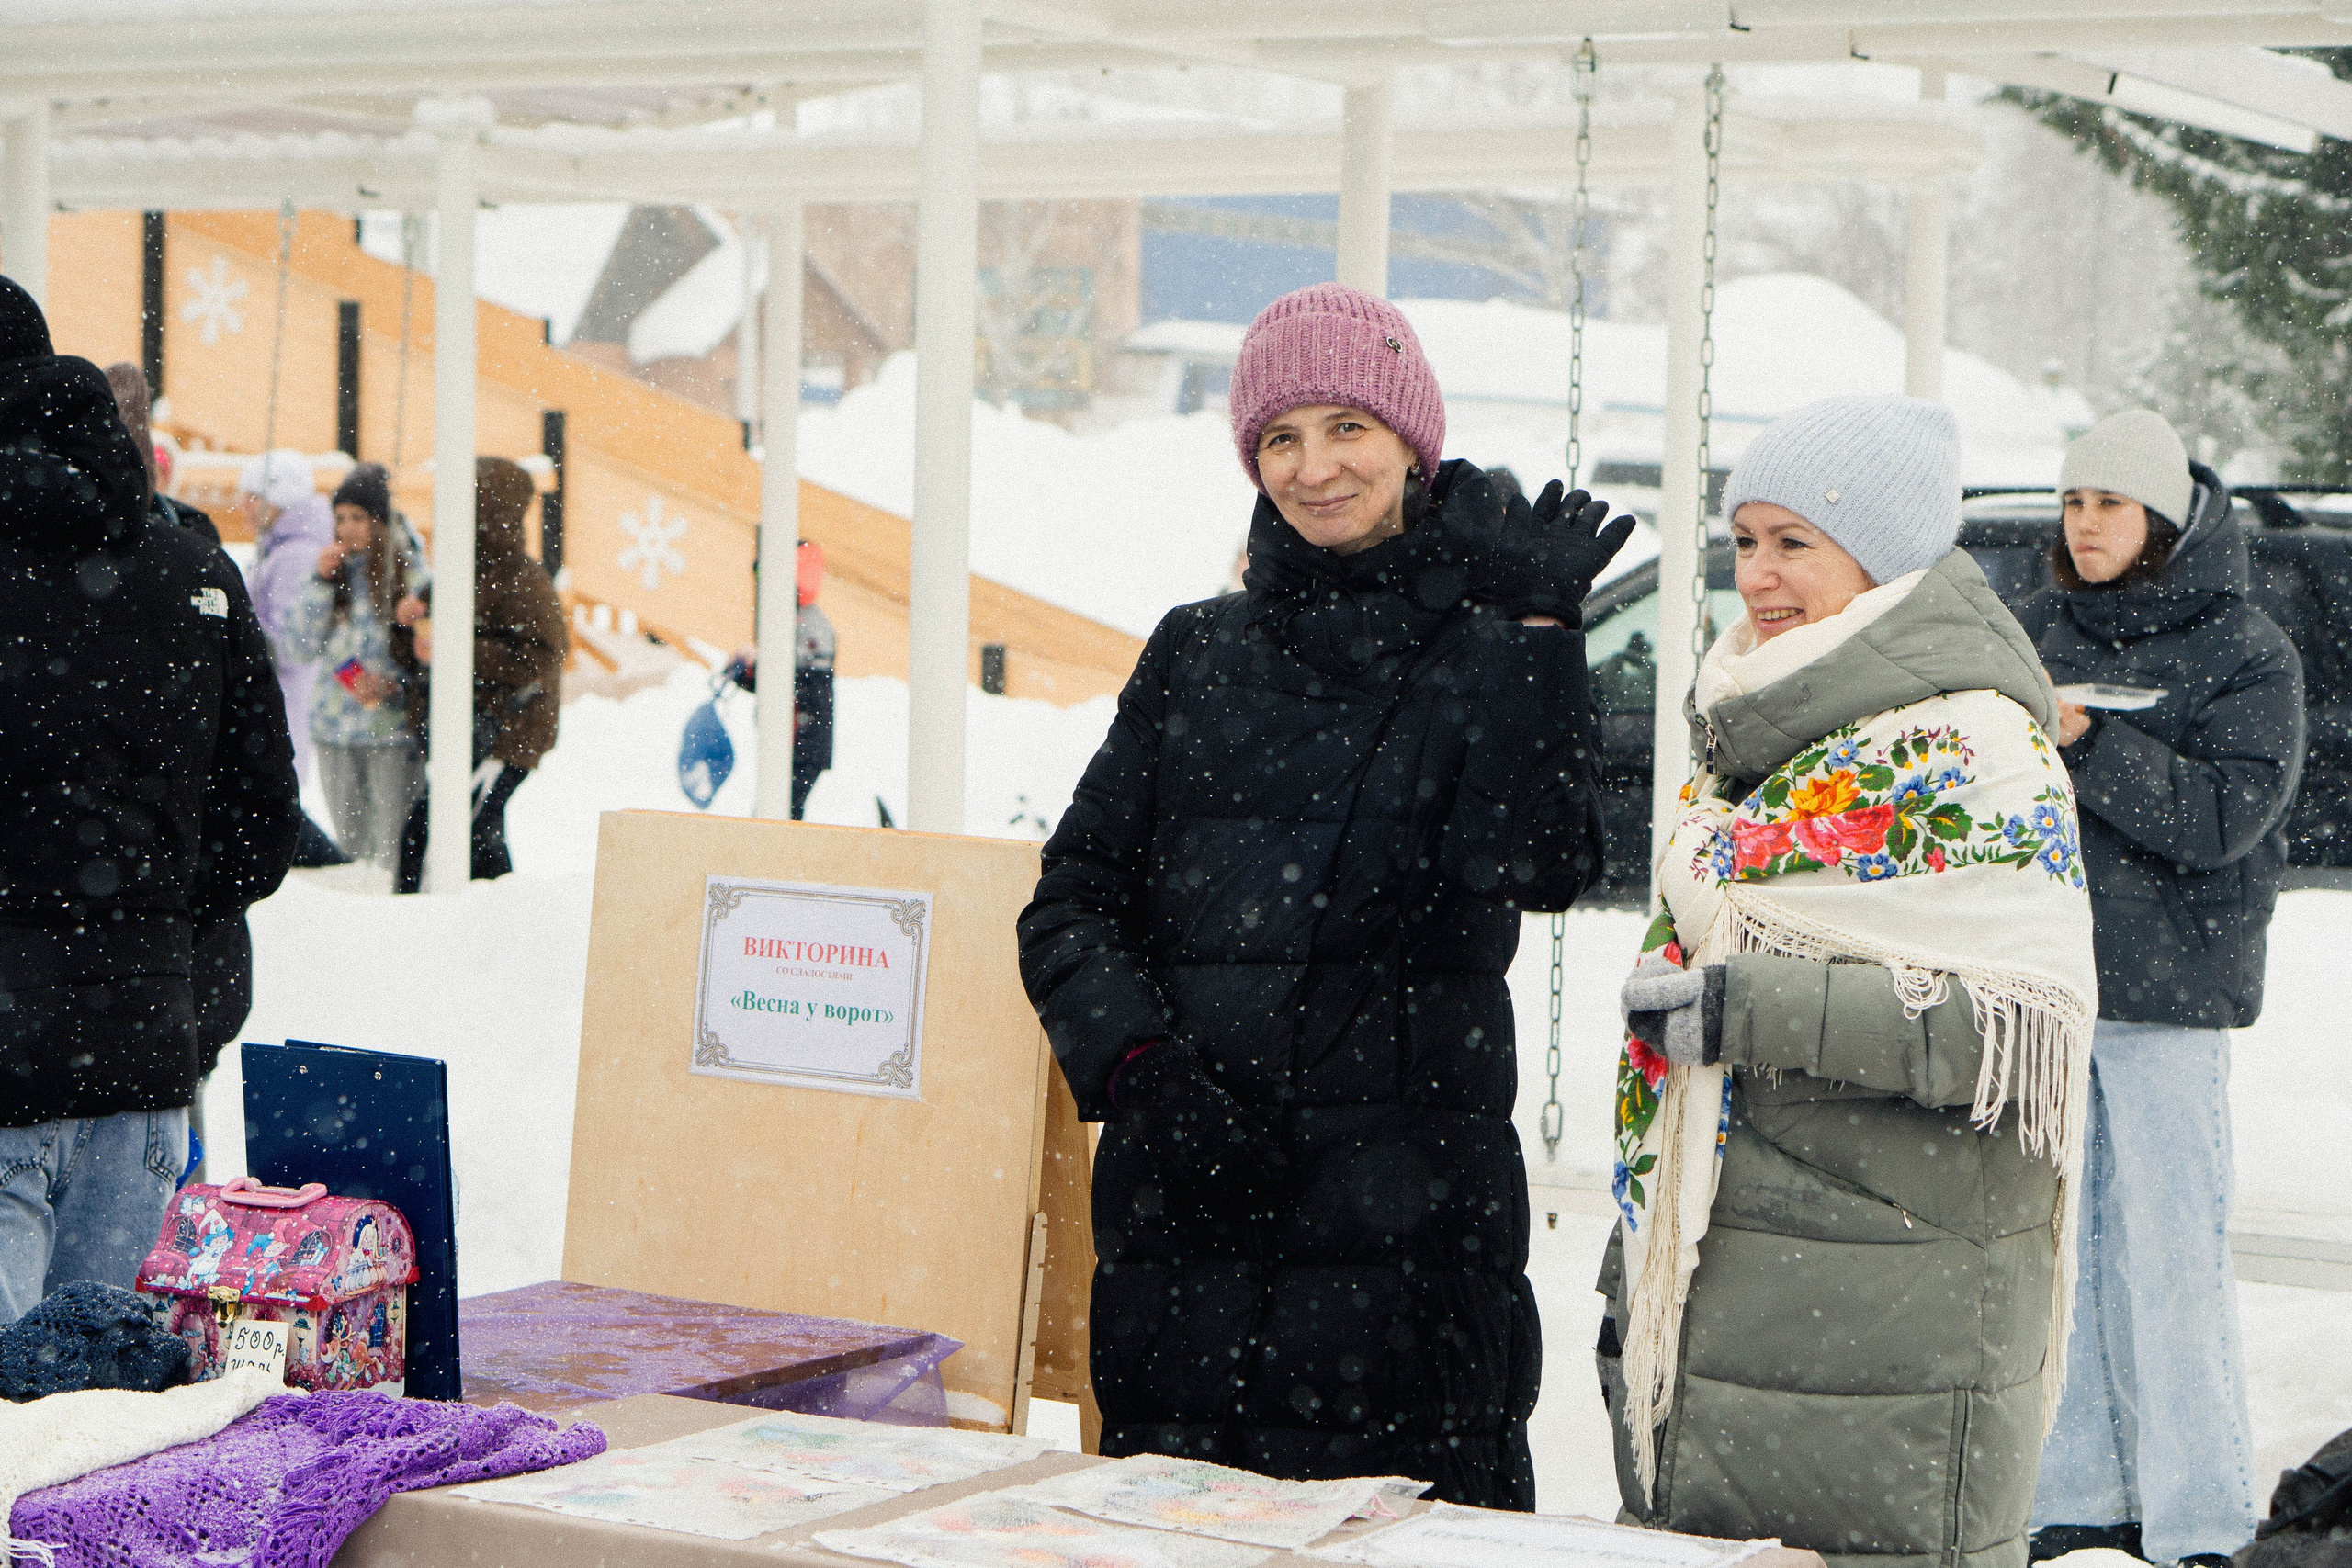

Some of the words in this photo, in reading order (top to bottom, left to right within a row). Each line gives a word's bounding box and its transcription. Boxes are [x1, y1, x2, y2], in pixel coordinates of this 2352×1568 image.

[744, 937, 889, 968] ВИКТОРИНА
[731, 990, 799, 1015] «Весна
[806, 1002, 818, 1021] у
[824, 1004, 894, 1026] ворот»
